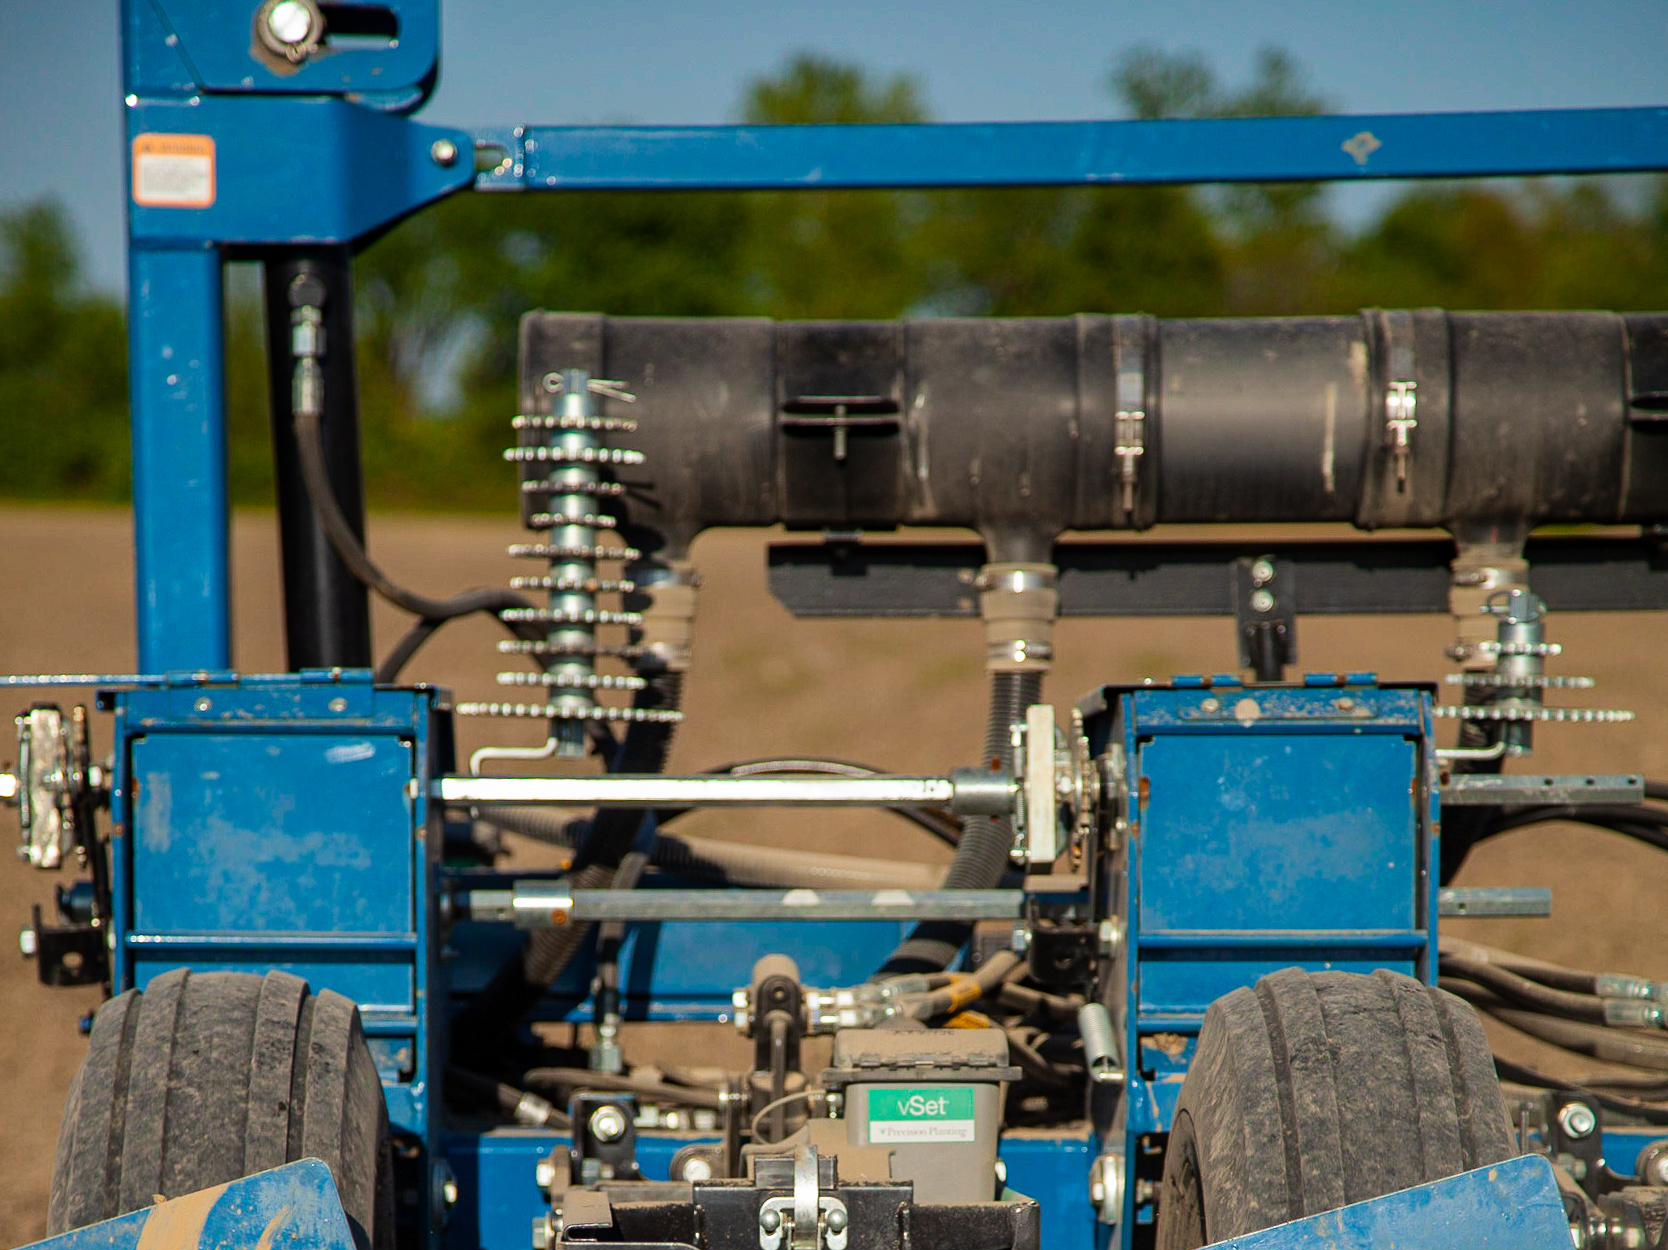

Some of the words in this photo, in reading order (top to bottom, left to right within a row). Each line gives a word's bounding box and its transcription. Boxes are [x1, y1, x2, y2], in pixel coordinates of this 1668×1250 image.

[897, 1095, 947, 1116] vSet
[887, 1126, 926, 1137] Precision
[929, 1126, 967, 1138] Planting
